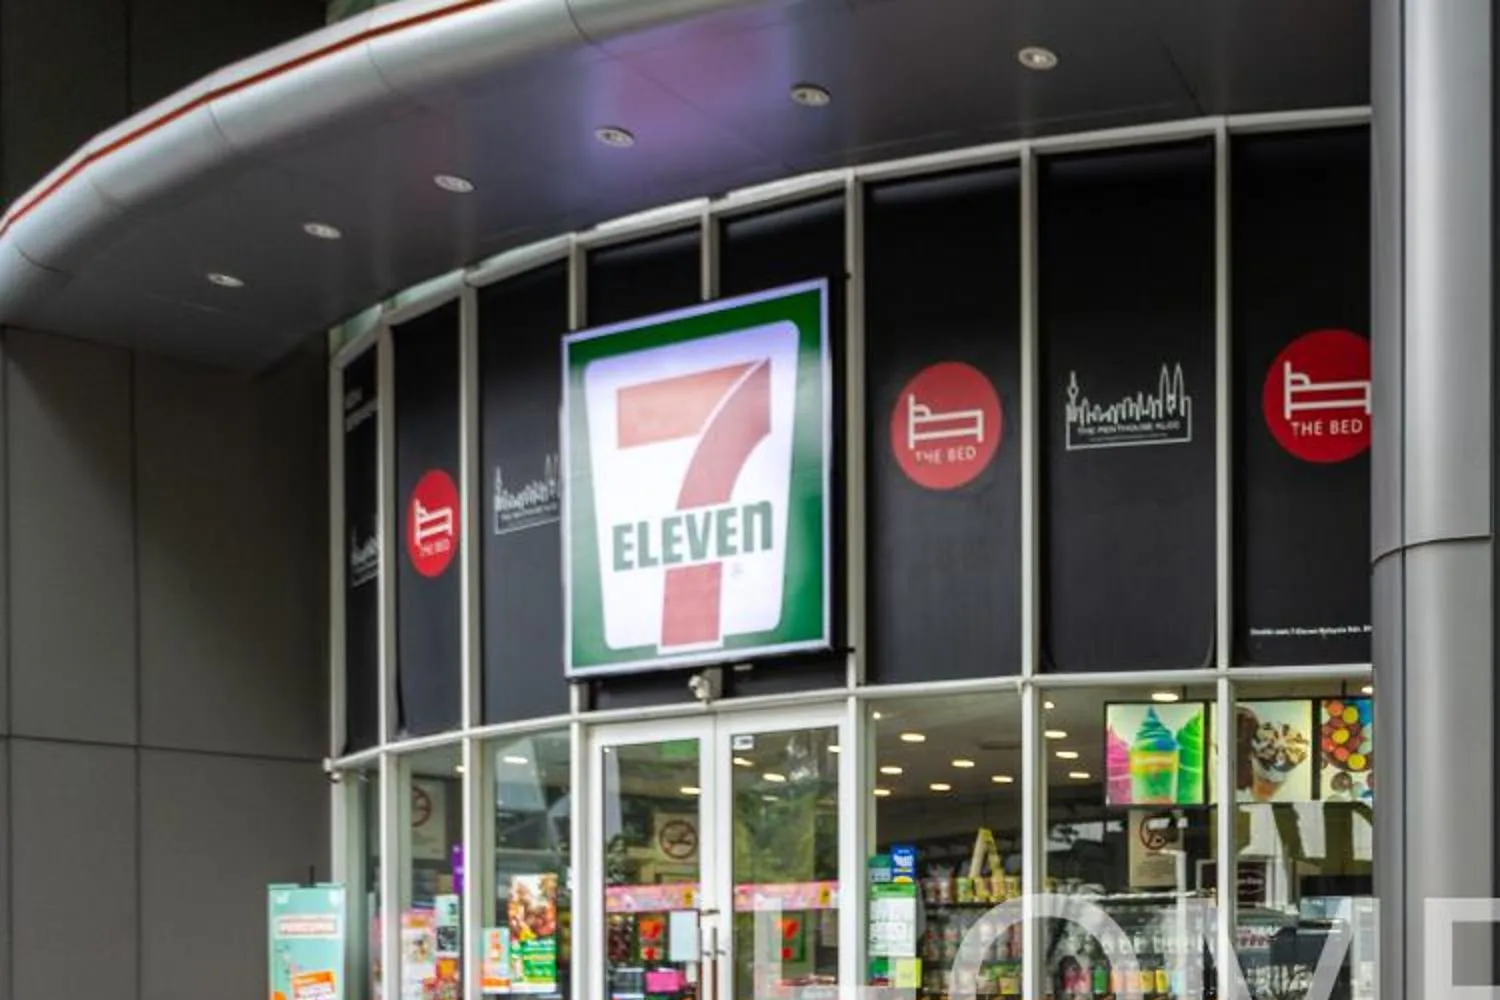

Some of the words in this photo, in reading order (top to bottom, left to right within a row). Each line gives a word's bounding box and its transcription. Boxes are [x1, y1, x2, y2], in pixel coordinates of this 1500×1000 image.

[1292, 420, 1325, 437] THE
[1329, 419, 1363, 435] BED
[914, 449, 942, 464] THE
[947, 446, 977, 462] BED
[617, 357, 771, 647] 7
